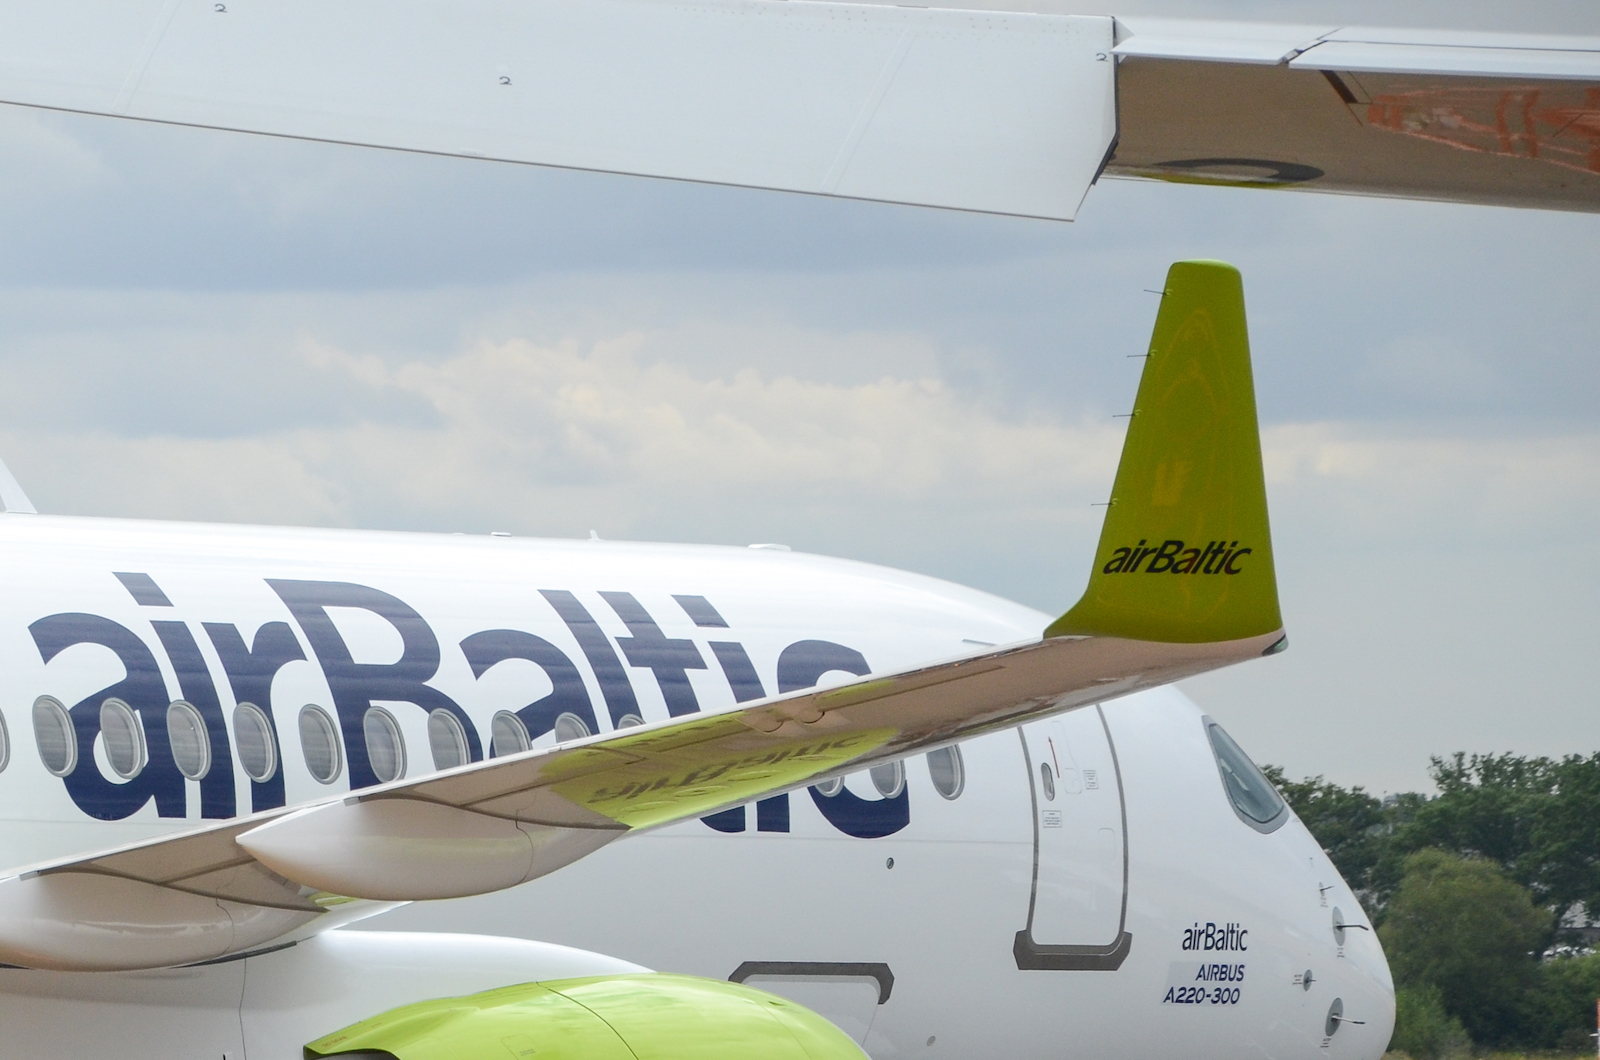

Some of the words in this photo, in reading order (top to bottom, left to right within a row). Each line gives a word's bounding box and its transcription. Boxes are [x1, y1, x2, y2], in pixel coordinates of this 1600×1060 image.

[1103, 539, 1252, 575] airBaltic
[28, 572, 910, 839] airBaltic
[1182, 922, 1248, 951] airBaltic
[1195, 964, 1245, 982] AIRBUS
[1163, 986, 1241, 1005] A220-300
